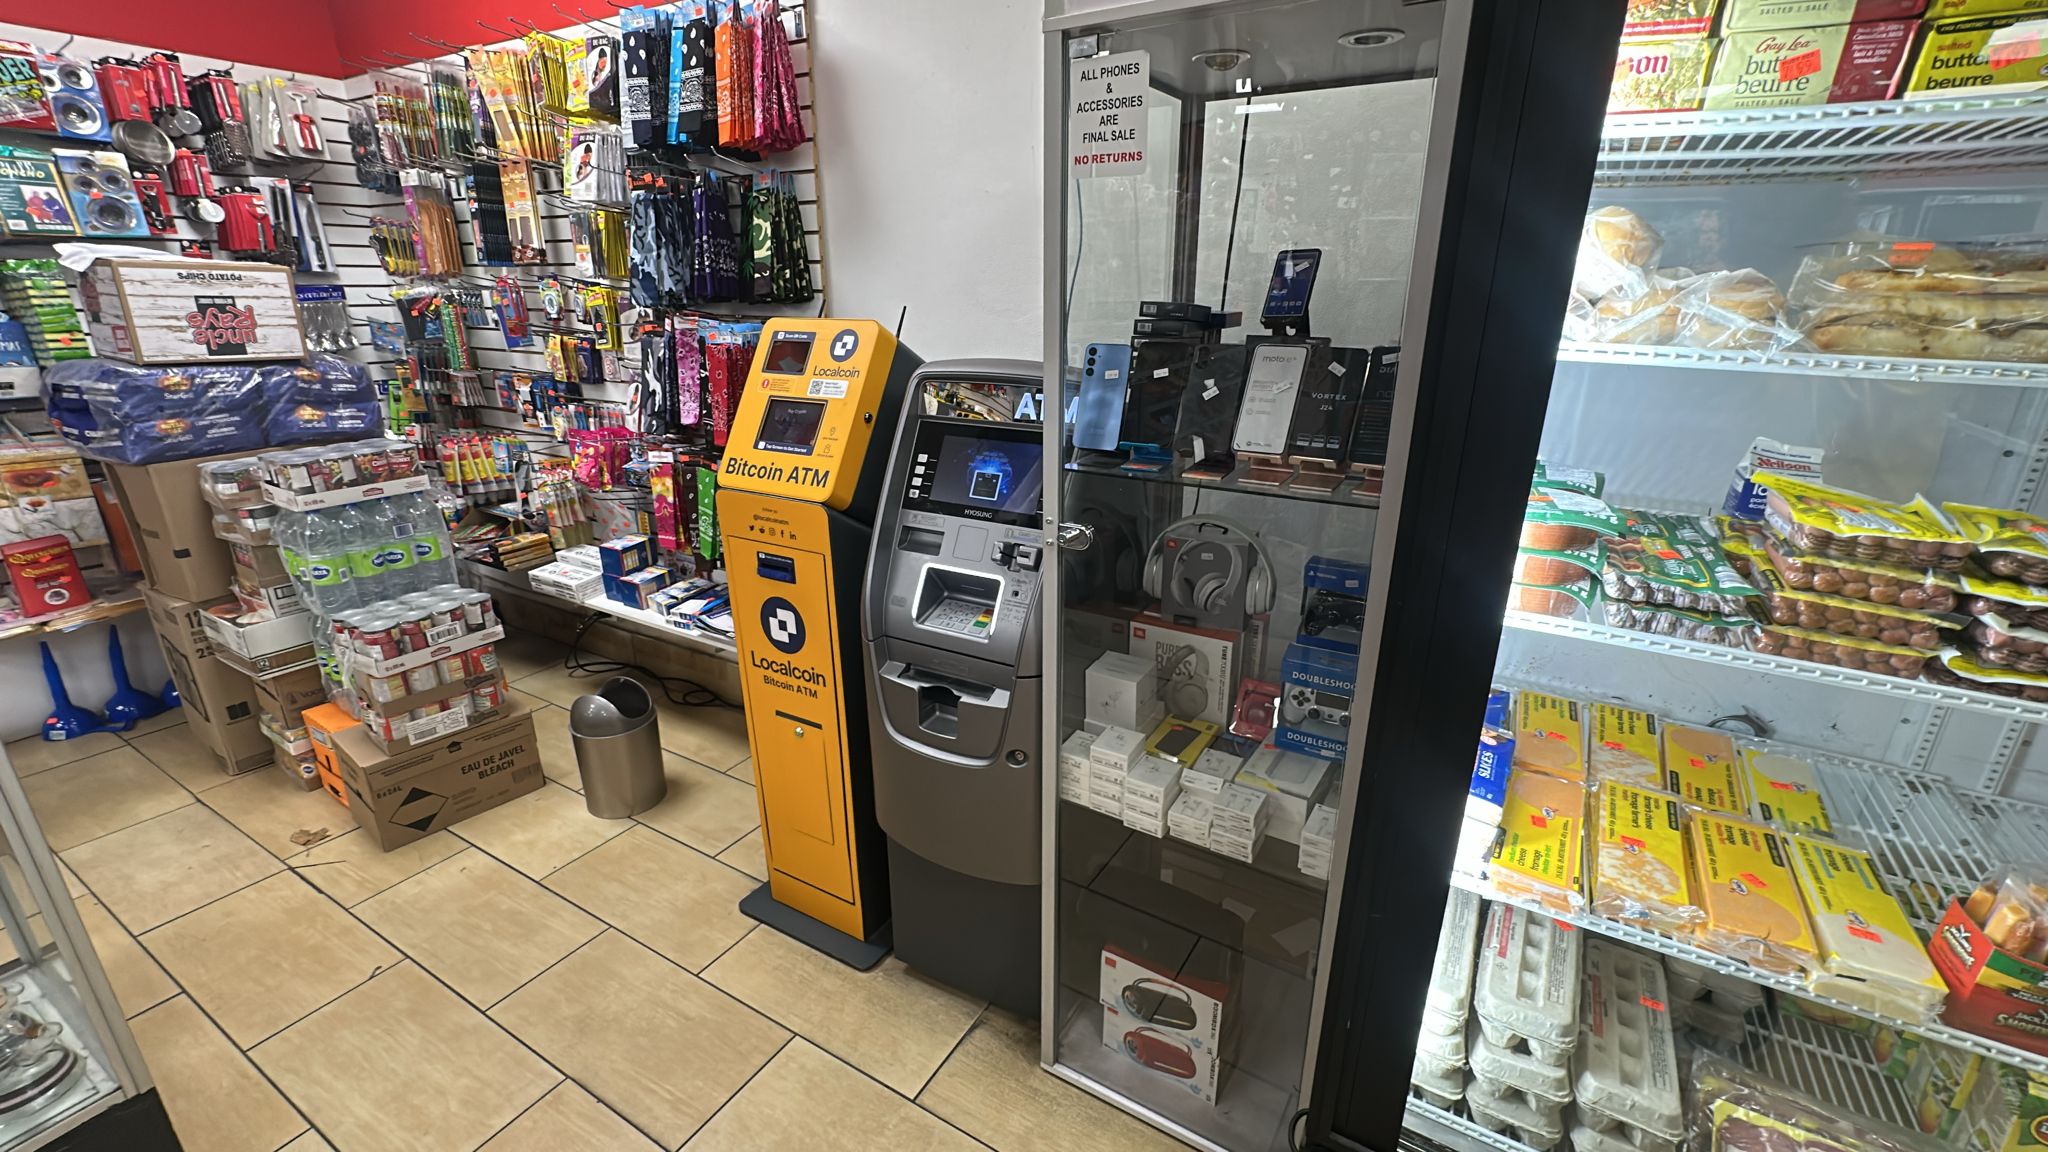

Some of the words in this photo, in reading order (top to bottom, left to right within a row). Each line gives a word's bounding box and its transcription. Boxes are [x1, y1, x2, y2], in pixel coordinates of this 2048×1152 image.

[1756, 36, 1787, 54] Gay
[1787, 34, 1811, 51] Lea
[1080, 68, 1098, 82] ALL
[1100, 62, 1140, 79] PHONES
[1744, 55, 1787, 76] but
[1106, 82, 1113, 94] &
[1926, 74, 1994, 90] beurre
[1076, 96, 1143, 114] ACCESSORIES
[1099, 114, 1118, 126] ARE
[1082, 132, 1110, 144] FINAL
[1111, 128, 1136, 140] SALE
[1074, 155, 1089, 166] NO
[1092, 151, 1142, 164] RETURNS
[177, 272, 206, 281] CHIPS
[208, 273, 242, 281] POTATO
[186, 304, 258, 330] Rays
[193, 328, 258, 350] uncle
[812, 366, 860, 378] Localcoin
[1312, 392, 1348, 400] VORTEX
[725, 457, 784, 481] Bitcoin
[786, 468, 830, 489] ATM
[1757, 457, 1812, 472] Neilson
[964, 508, 992, 518] HYOSUNG
[750, 650, 827, 688] Localcoin
[764, 674, 794, 692] Bitcoin
[796, 684, 818, 700] ATM
[461, 760, 481, 775] EAU
[482, 756, 496, 767] DE
[498, 744, 526, 761] JAVEL
[1478, 750, 1494, 779] SLICES
[478, 760, 514, 780] BLEACH
